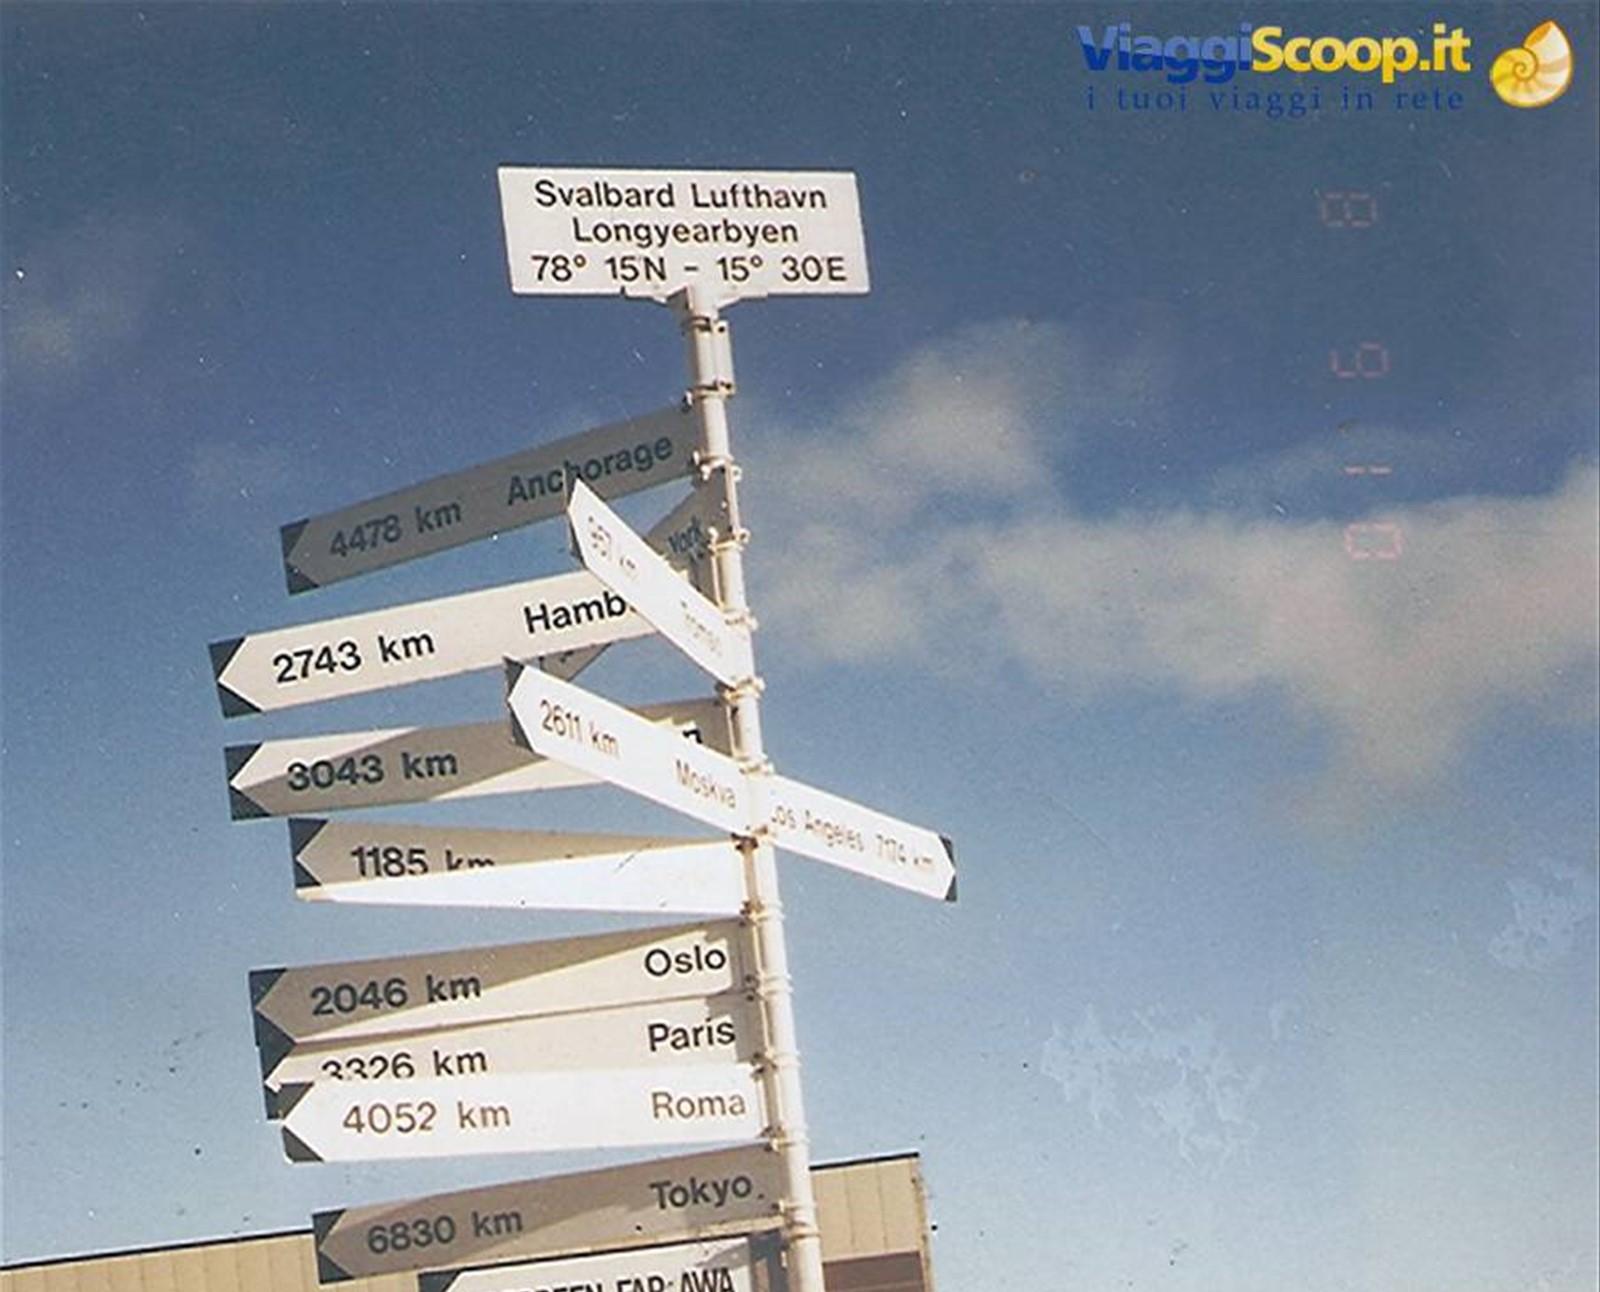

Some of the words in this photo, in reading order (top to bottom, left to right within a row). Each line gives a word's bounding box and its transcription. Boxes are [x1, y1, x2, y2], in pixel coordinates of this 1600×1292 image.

[534, 179, 675, 209] Svalbard
[691, 183, 827, 210] Lufthavn
[573, 216, 798, 248] Longyearbyen
[531, 255, 588, 283] 78°
[717, 257, 763, 282] 15°
[328, 514, 401, 558] 4478
[415, 499, 463, 534] km
[507, 436, 674, 506] Anchorage
[273, 641, 362, 684] 2743
[378, 628, 436, 663] km
[523, 590, 636, 635] Hamb
[287, 754, 384, 792] 3043
[401, 750, 458, 781] km
[540, 698, 584, 743] 2611
[588, 722, 620, 761] km
[673, 757, 738, 809] Moskva
[350, 846, 429, 878] 1185
[445, 849, 495, 871] km
[310, 976, 408, 1018] 2046
[426, 974, 481, 1003] km
[644, 942, 727, 978] Oslo
[322, 1051, 415, 1080] 3326
[432, 1049, 488, 1077] km
[648, 1016, 737, 1052] Paris
[343, 1101, 437, 1133] 4052
[457, 1101, 511, 1129] km
[651, 1090, 746, 1120] Roma
[367, 1215, 456, 1255] 6830
[472, 1209, 523, 1239] km
[649, 1175, 752, 1210] Tokyo
